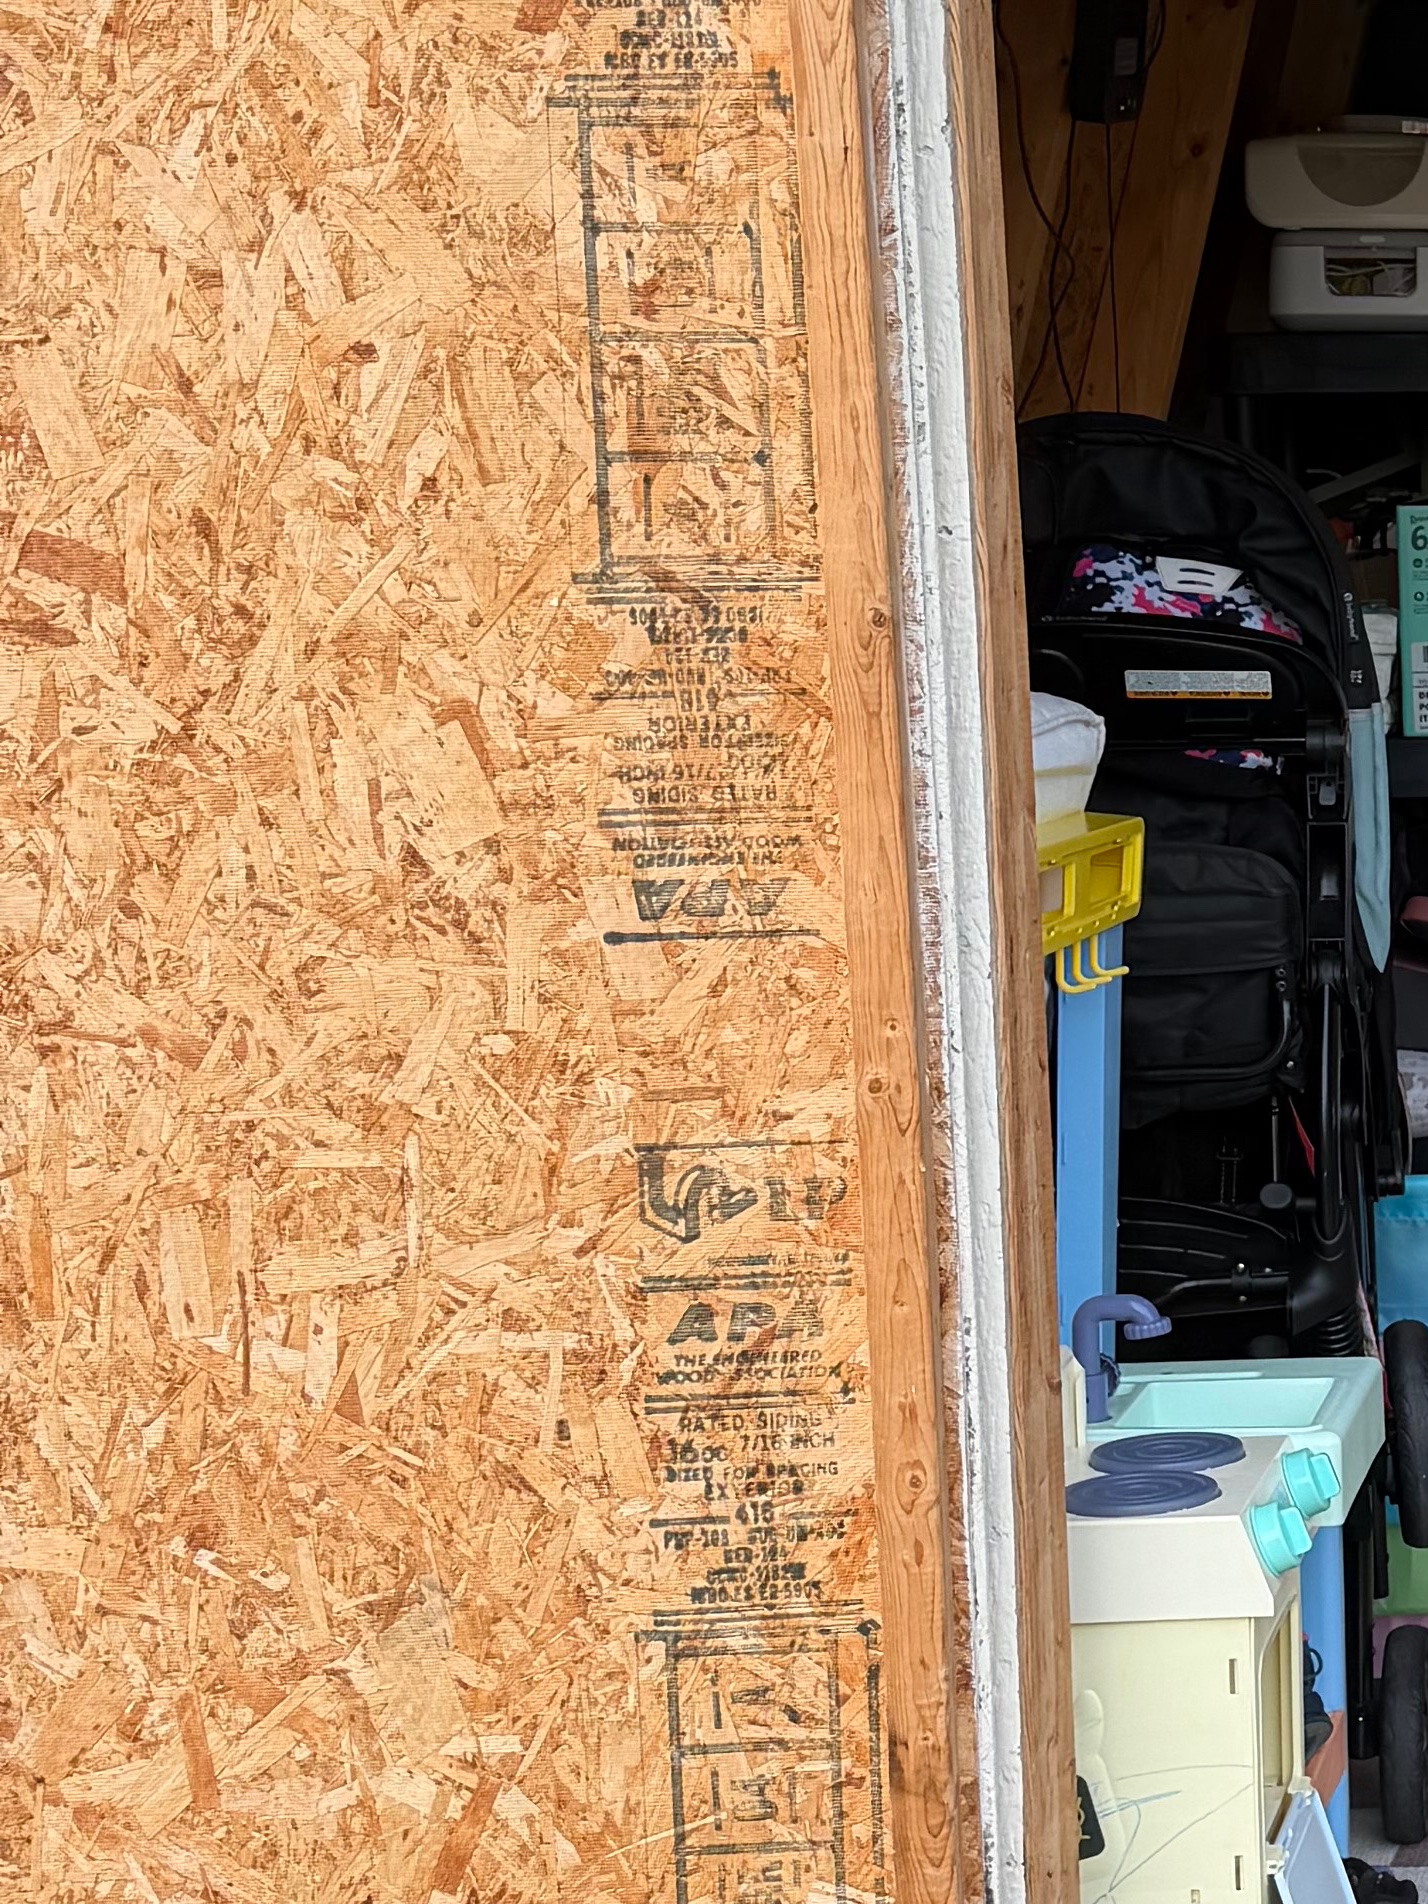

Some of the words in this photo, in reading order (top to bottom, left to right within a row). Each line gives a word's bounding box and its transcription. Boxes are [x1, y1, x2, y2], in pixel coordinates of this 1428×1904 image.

[1411, 526, 1428, 551] 6
[666, 1300, 825, 1346] APA
[679, 1413, 745, 1433] RATED
[757, 1410, 823, 1430] SIDING
